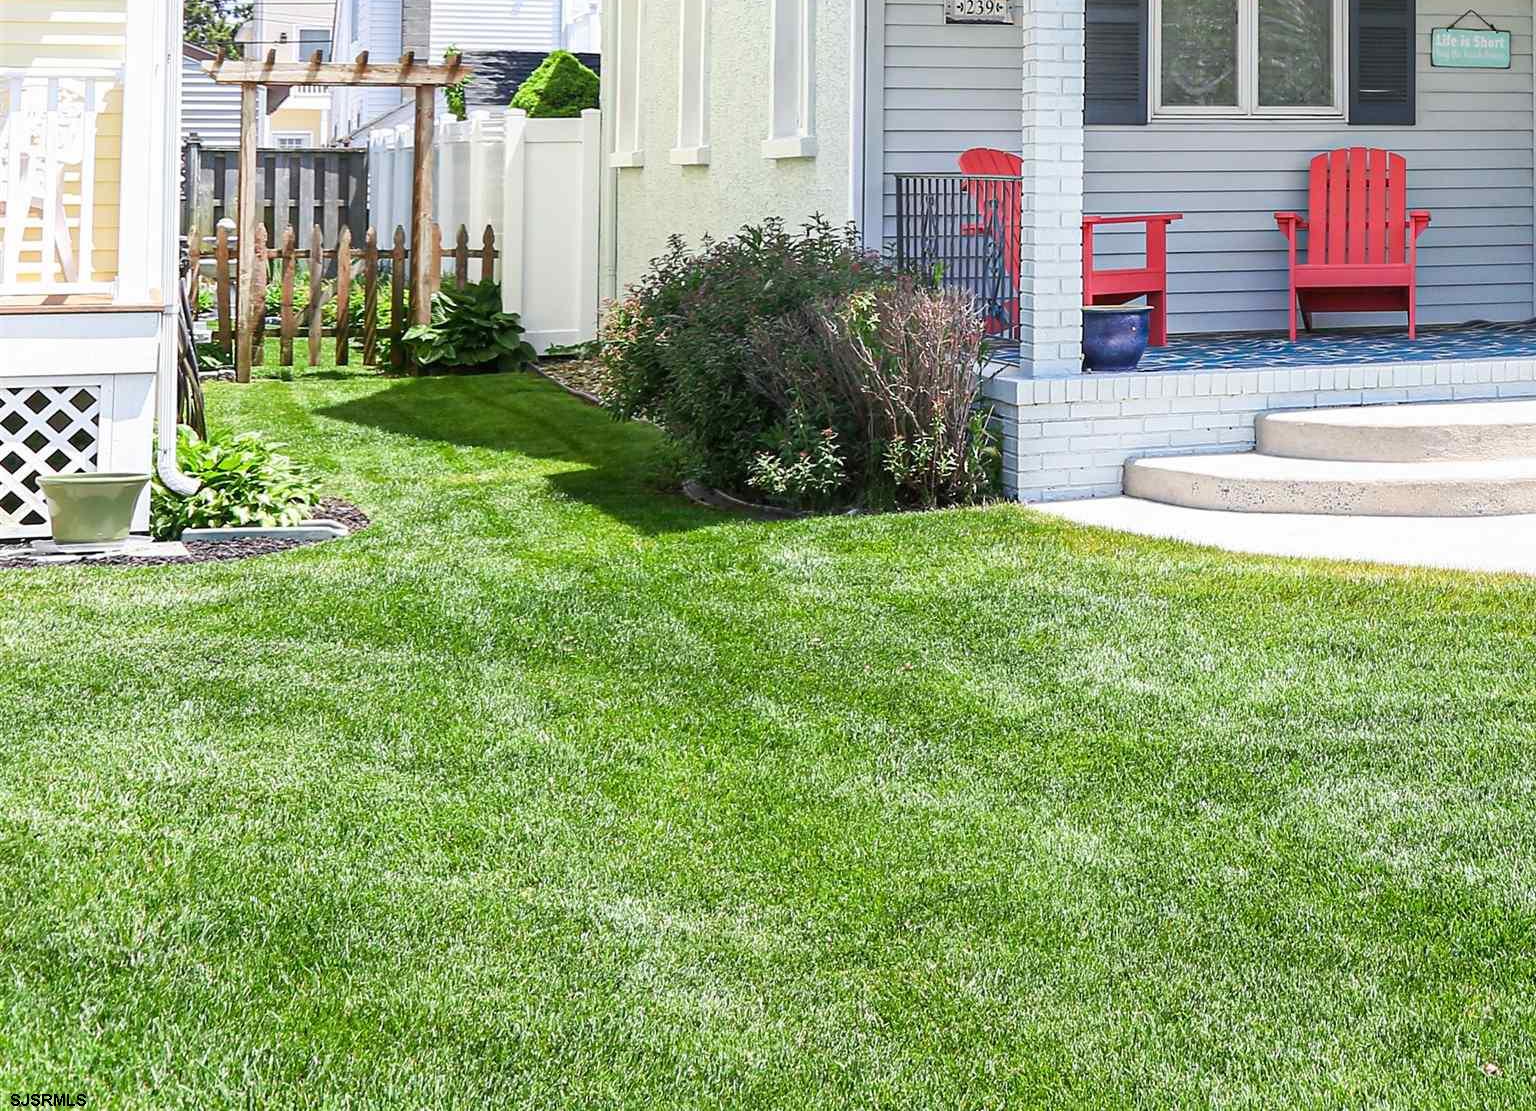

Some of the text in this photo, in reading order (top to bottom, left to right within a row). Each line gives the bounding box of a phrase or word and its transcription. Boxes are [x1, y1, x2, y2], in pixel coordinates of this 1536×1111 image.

[966, 0, 994, 15] 239
[1435, 33, 1505, 49] Life is Short
